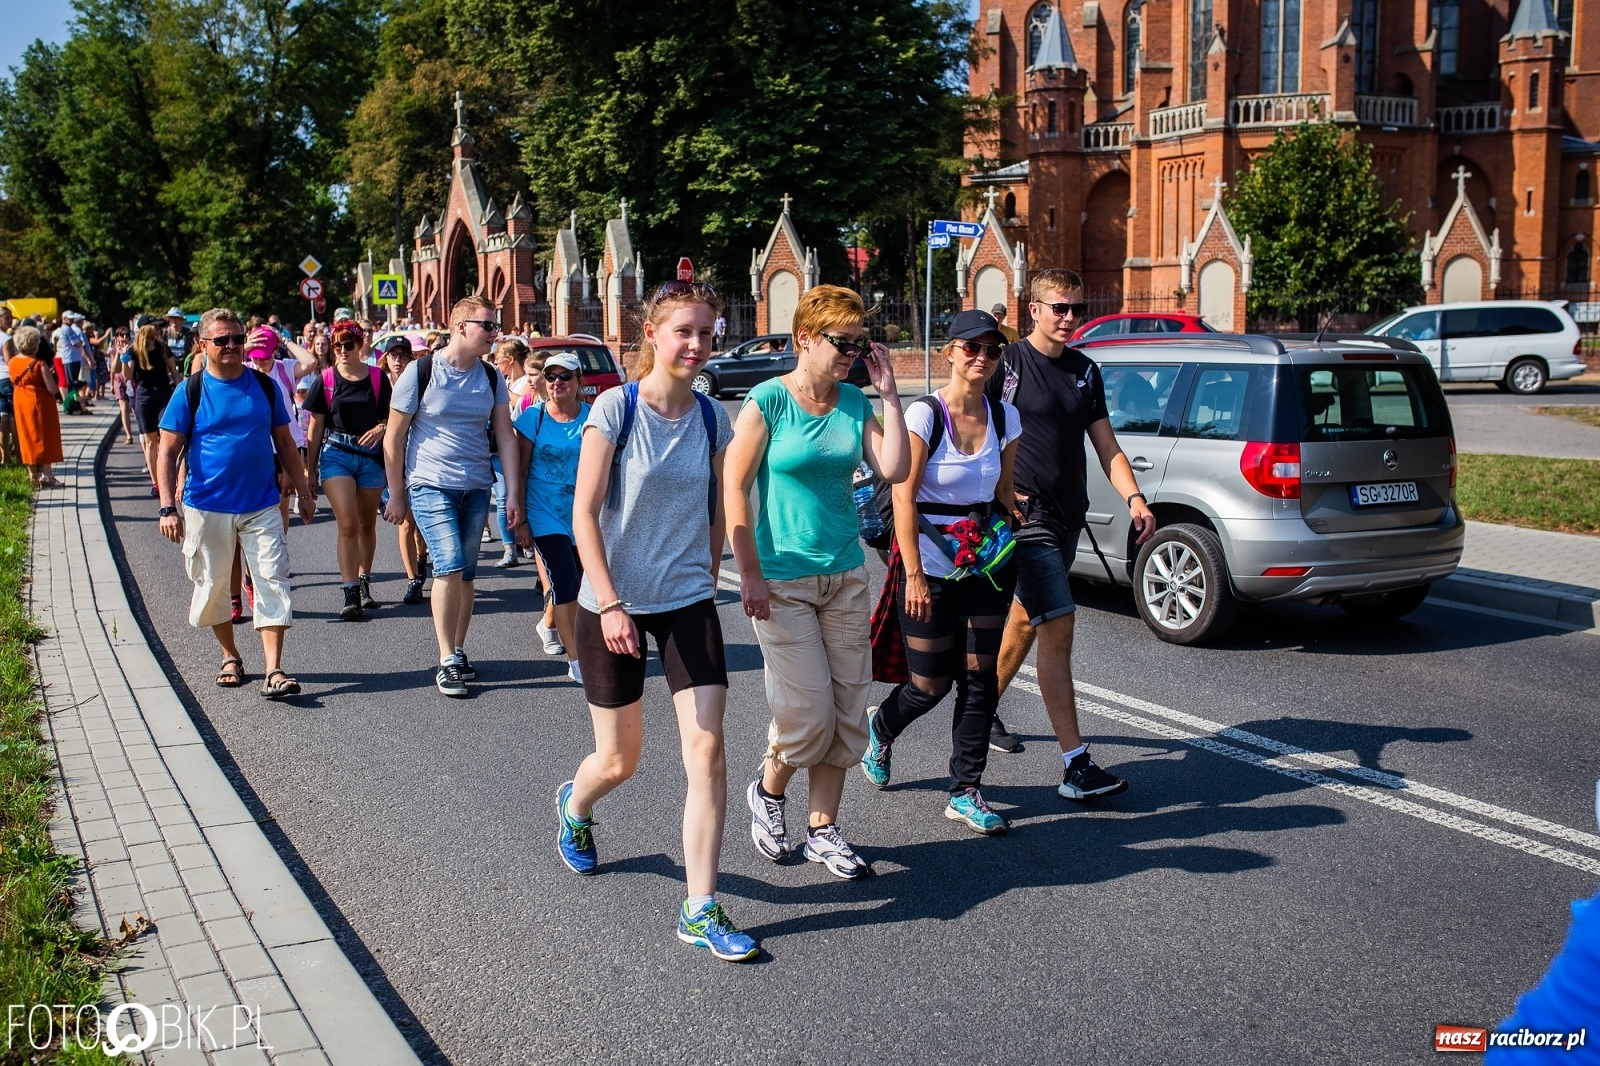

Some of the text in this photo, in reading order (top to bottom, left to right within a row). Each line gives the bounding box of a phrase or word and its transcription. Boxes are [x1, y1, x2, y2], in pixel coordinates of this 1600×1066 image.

[680, 269, 692, 280] STOP
[1359, 483, 1417, 503] SG 3270R
